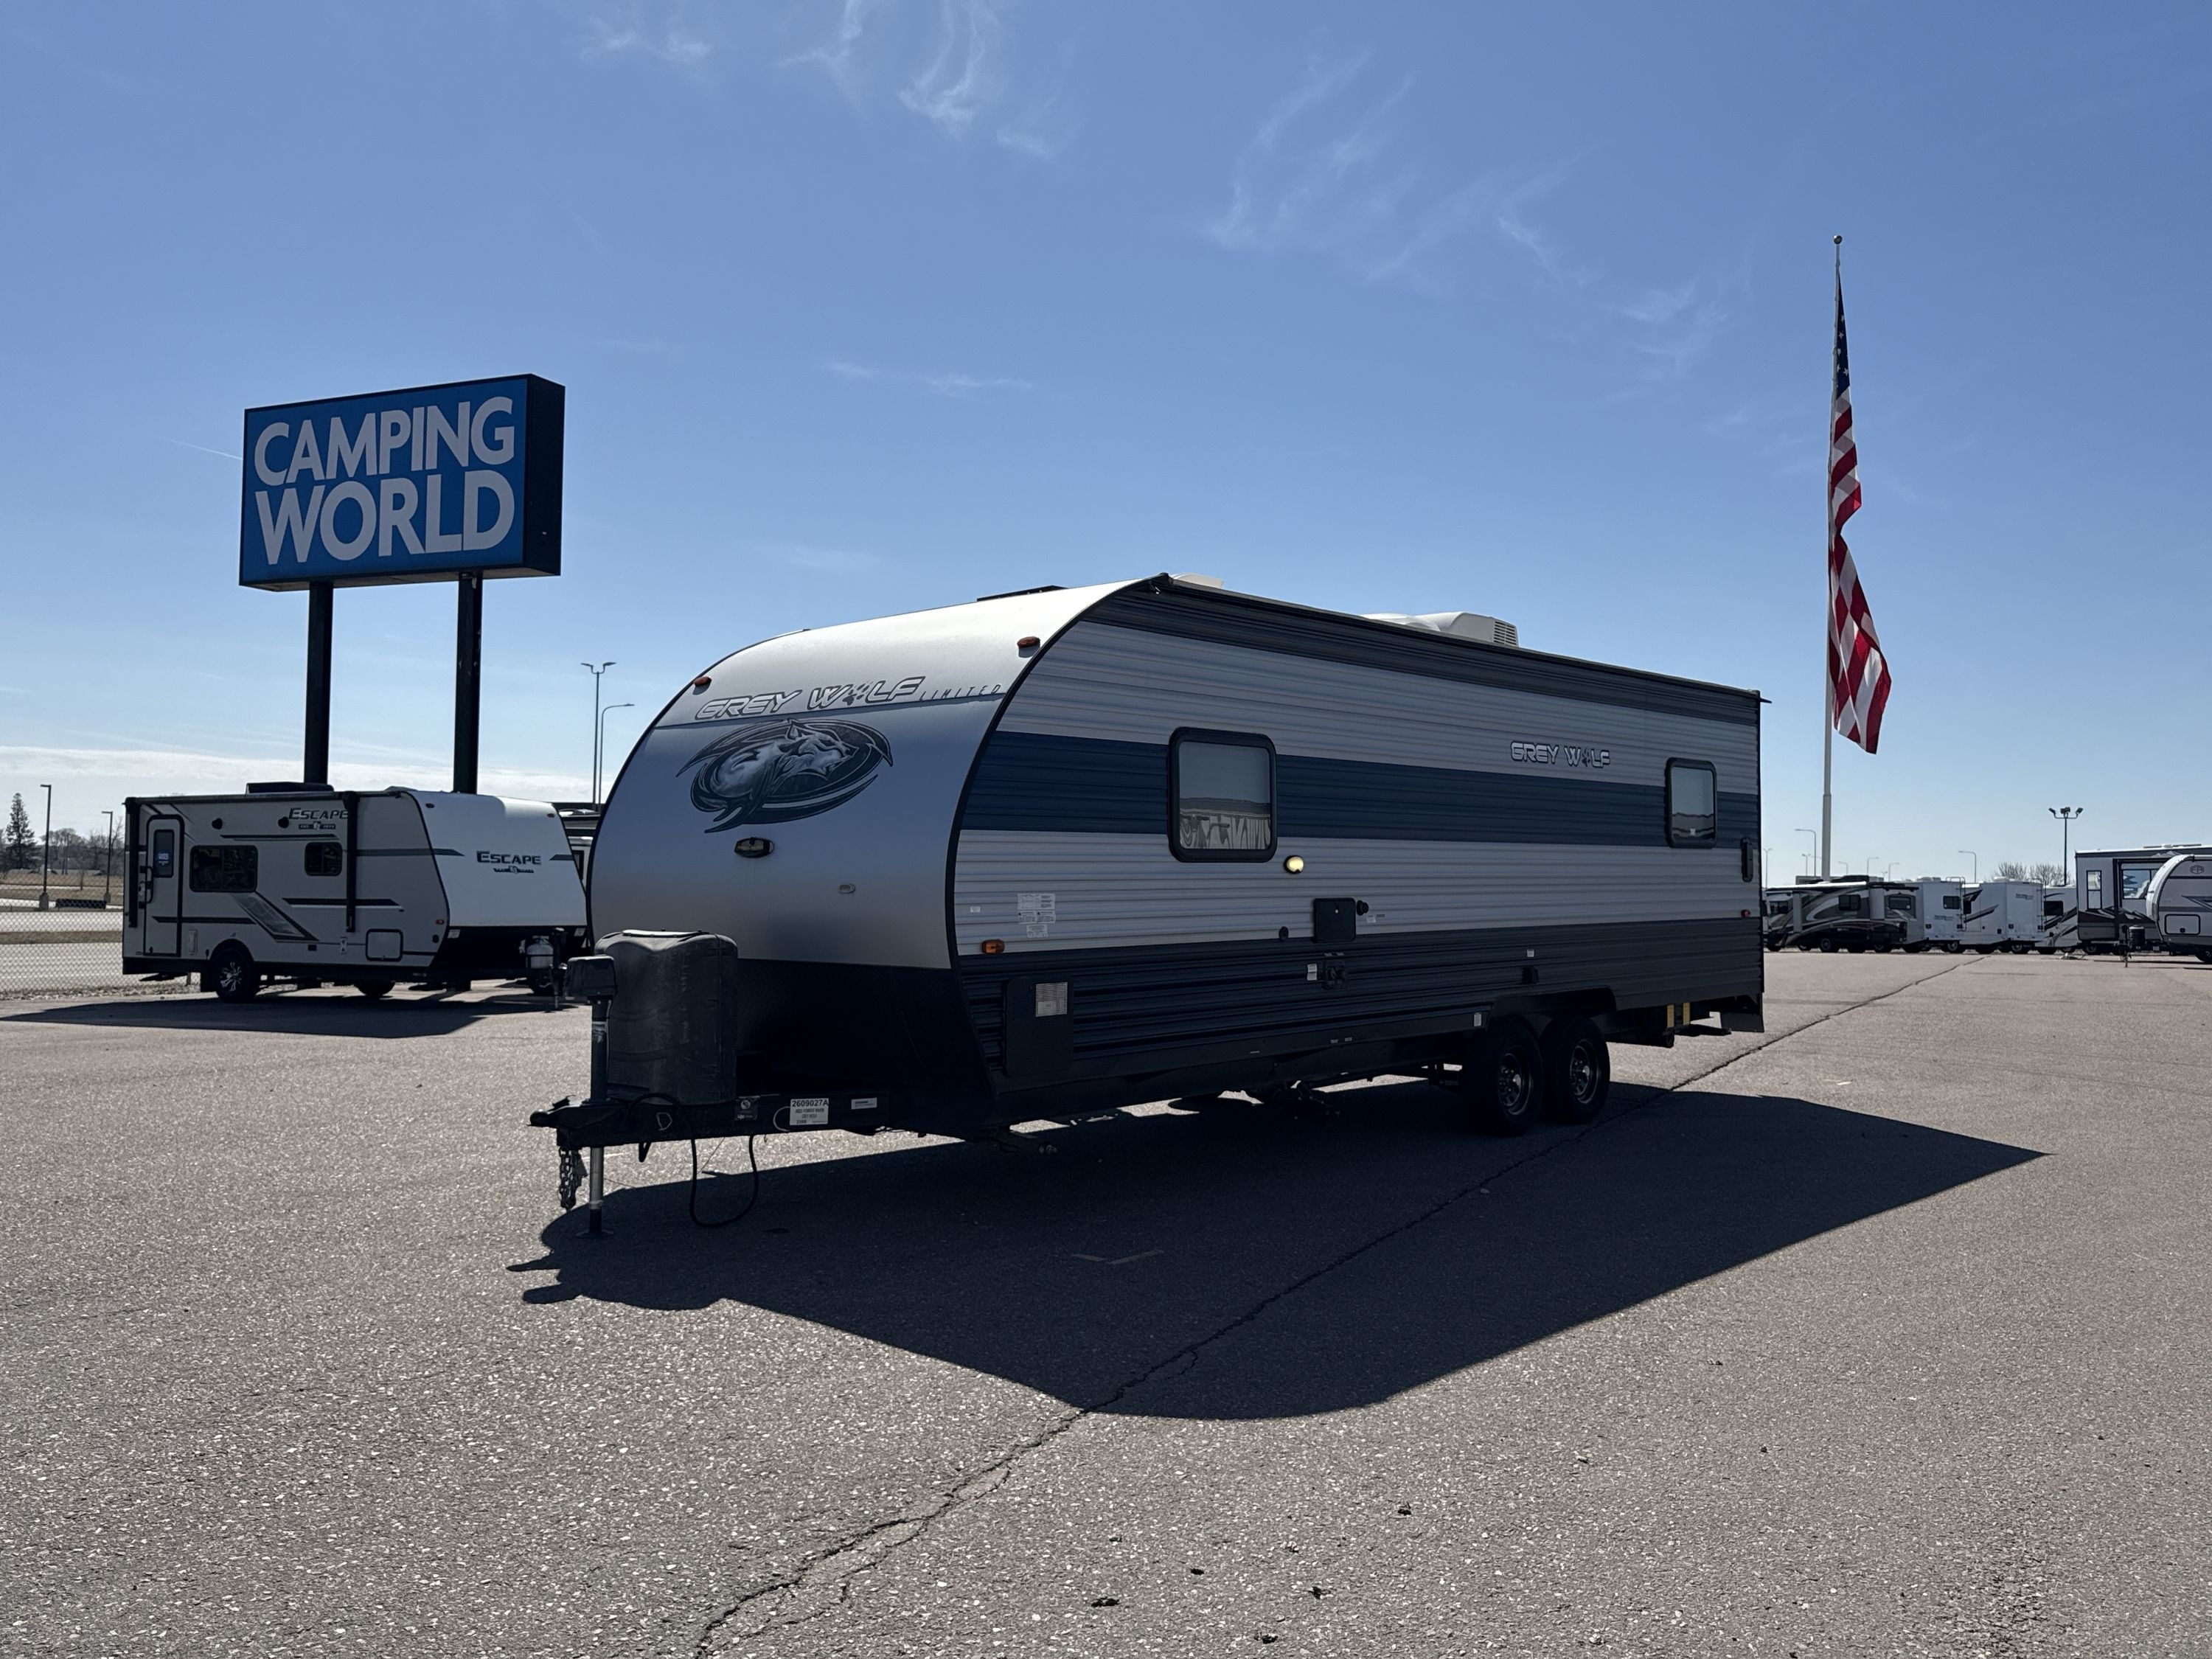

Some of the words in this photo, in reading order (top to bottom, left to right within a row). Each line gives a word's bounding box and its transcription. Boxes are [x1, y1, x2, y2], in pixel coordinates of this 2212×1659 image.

[254, 396, 515, 486] CAMPING
[255, 470, 515, 565] WORLD
[695, 689, 801, 720] GREY
[919, 684, 1001, 703] LIMITED
[1511, 741, 1559, 765] GREY
[289, 807, 348, 819] ESCAPE
[476, 851, 541, 865] ESCAPE
[792, 1099, 829, 1107] 2609027A
